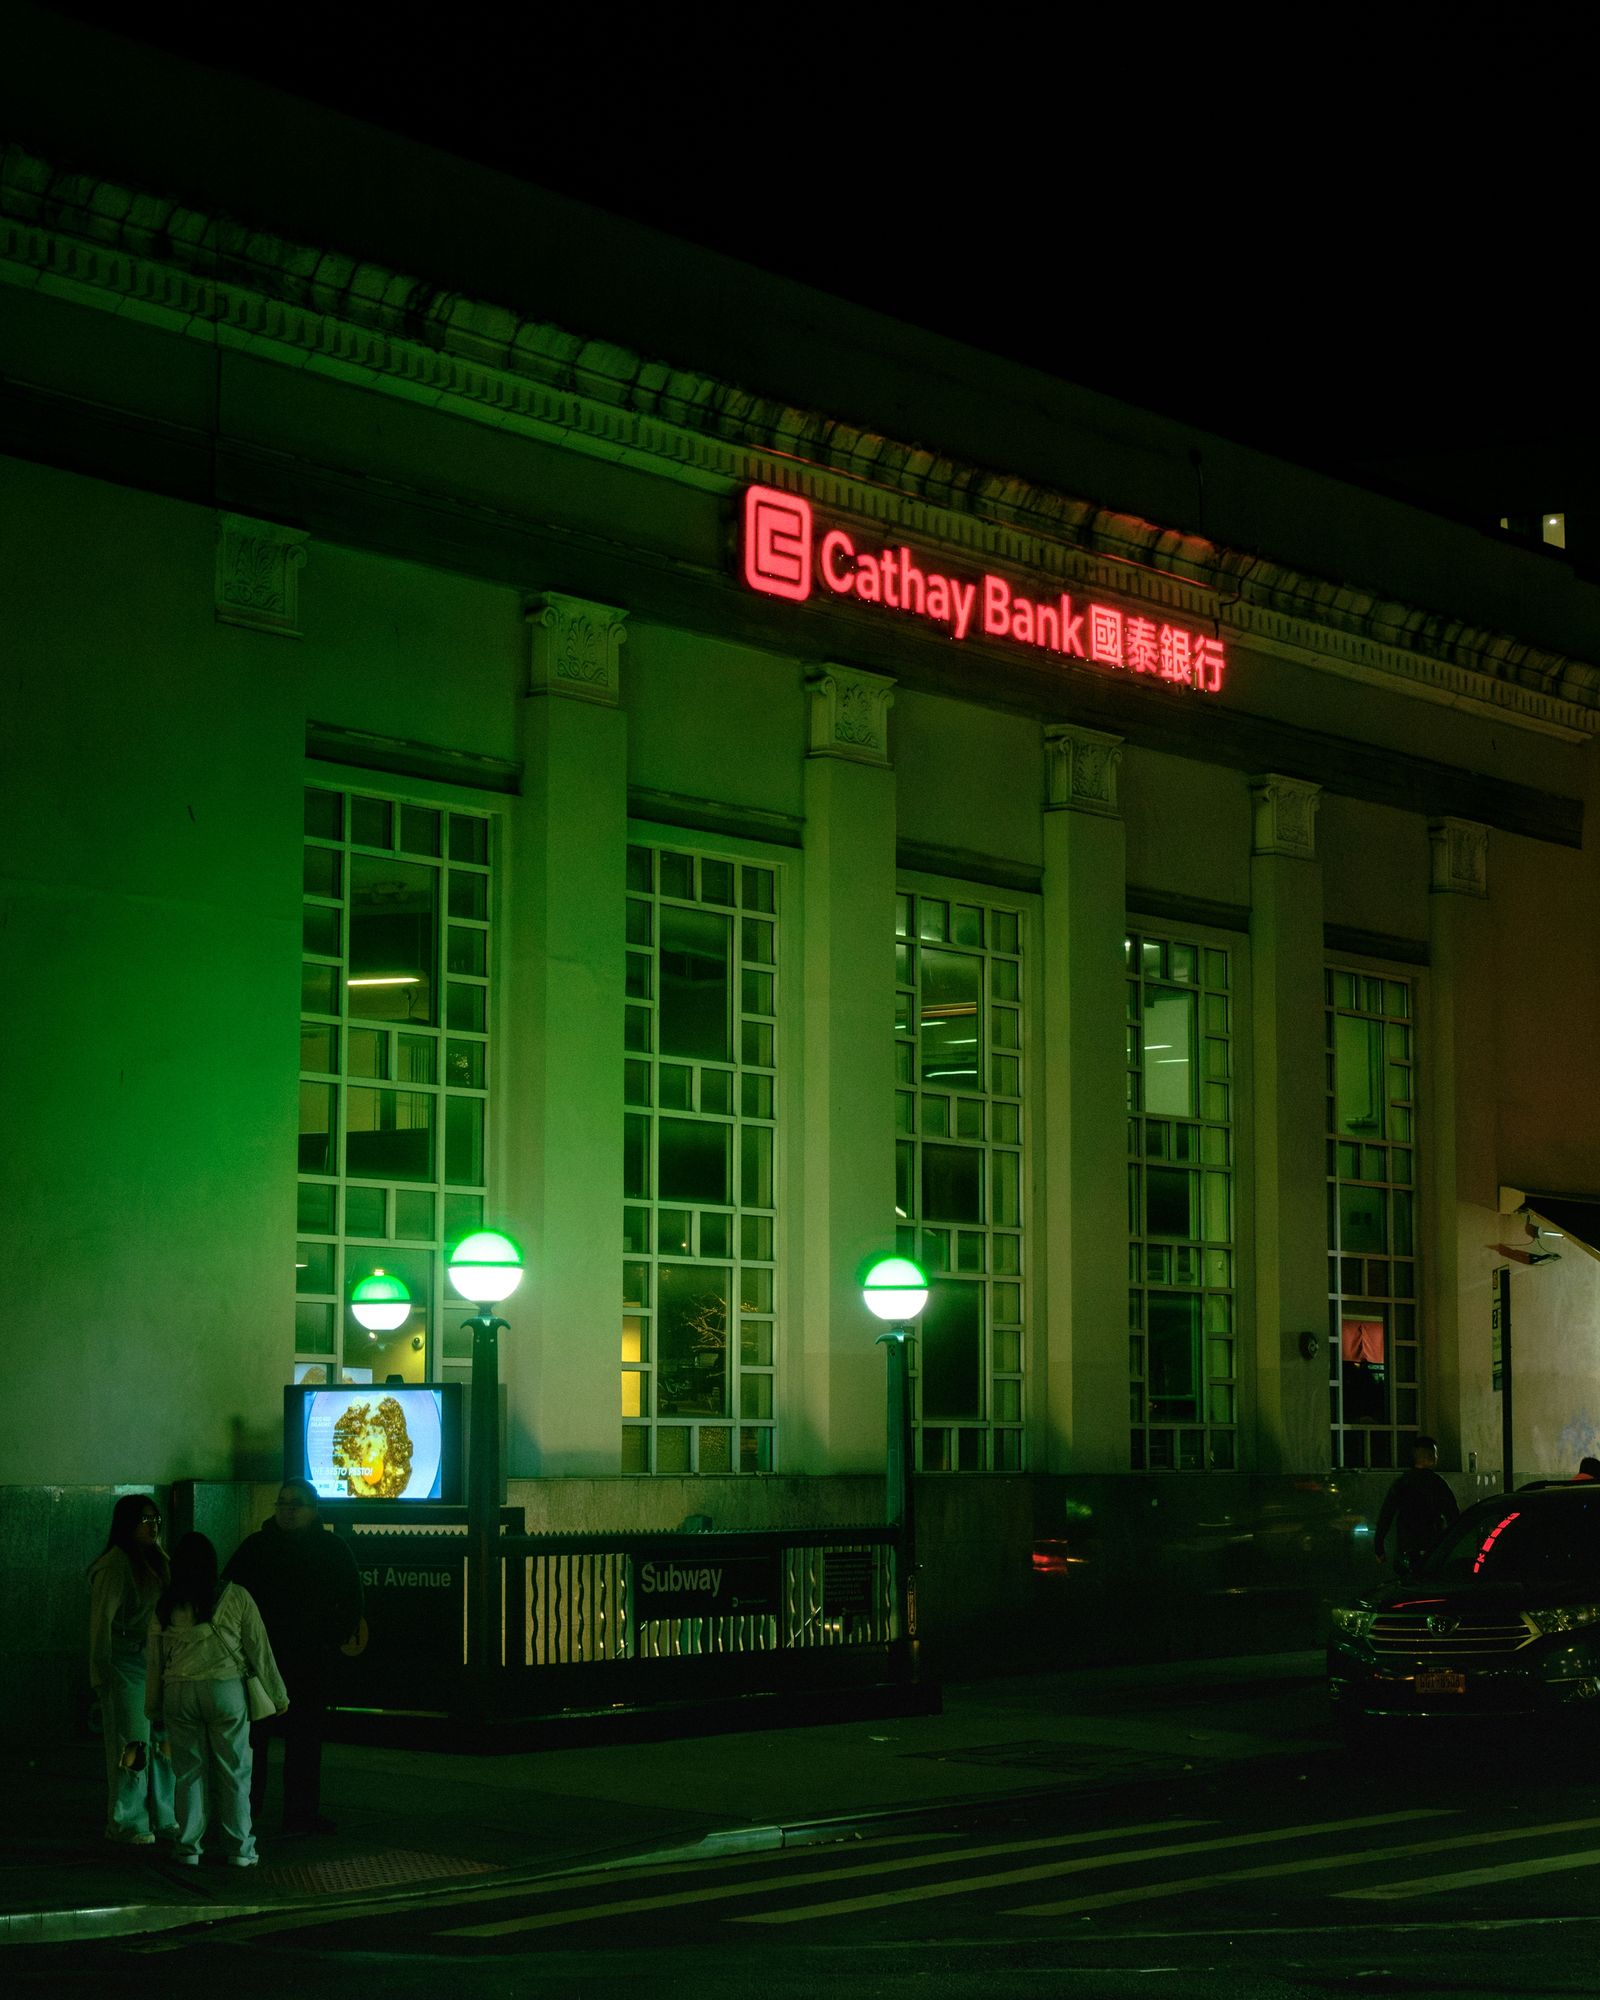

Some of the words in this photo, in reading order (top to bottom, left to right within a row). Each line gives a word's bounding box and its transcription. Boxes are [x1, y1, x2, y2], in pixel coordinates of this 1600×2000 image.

[821, 530, 975, 639] Cathay
[984, 574, 1086, 658] Bank
[1090, 603, 1225, 692] 國泰銀行
[384, 1567, 451, 1587] Avenue
[641, 1562, 722, 1598] Subway
